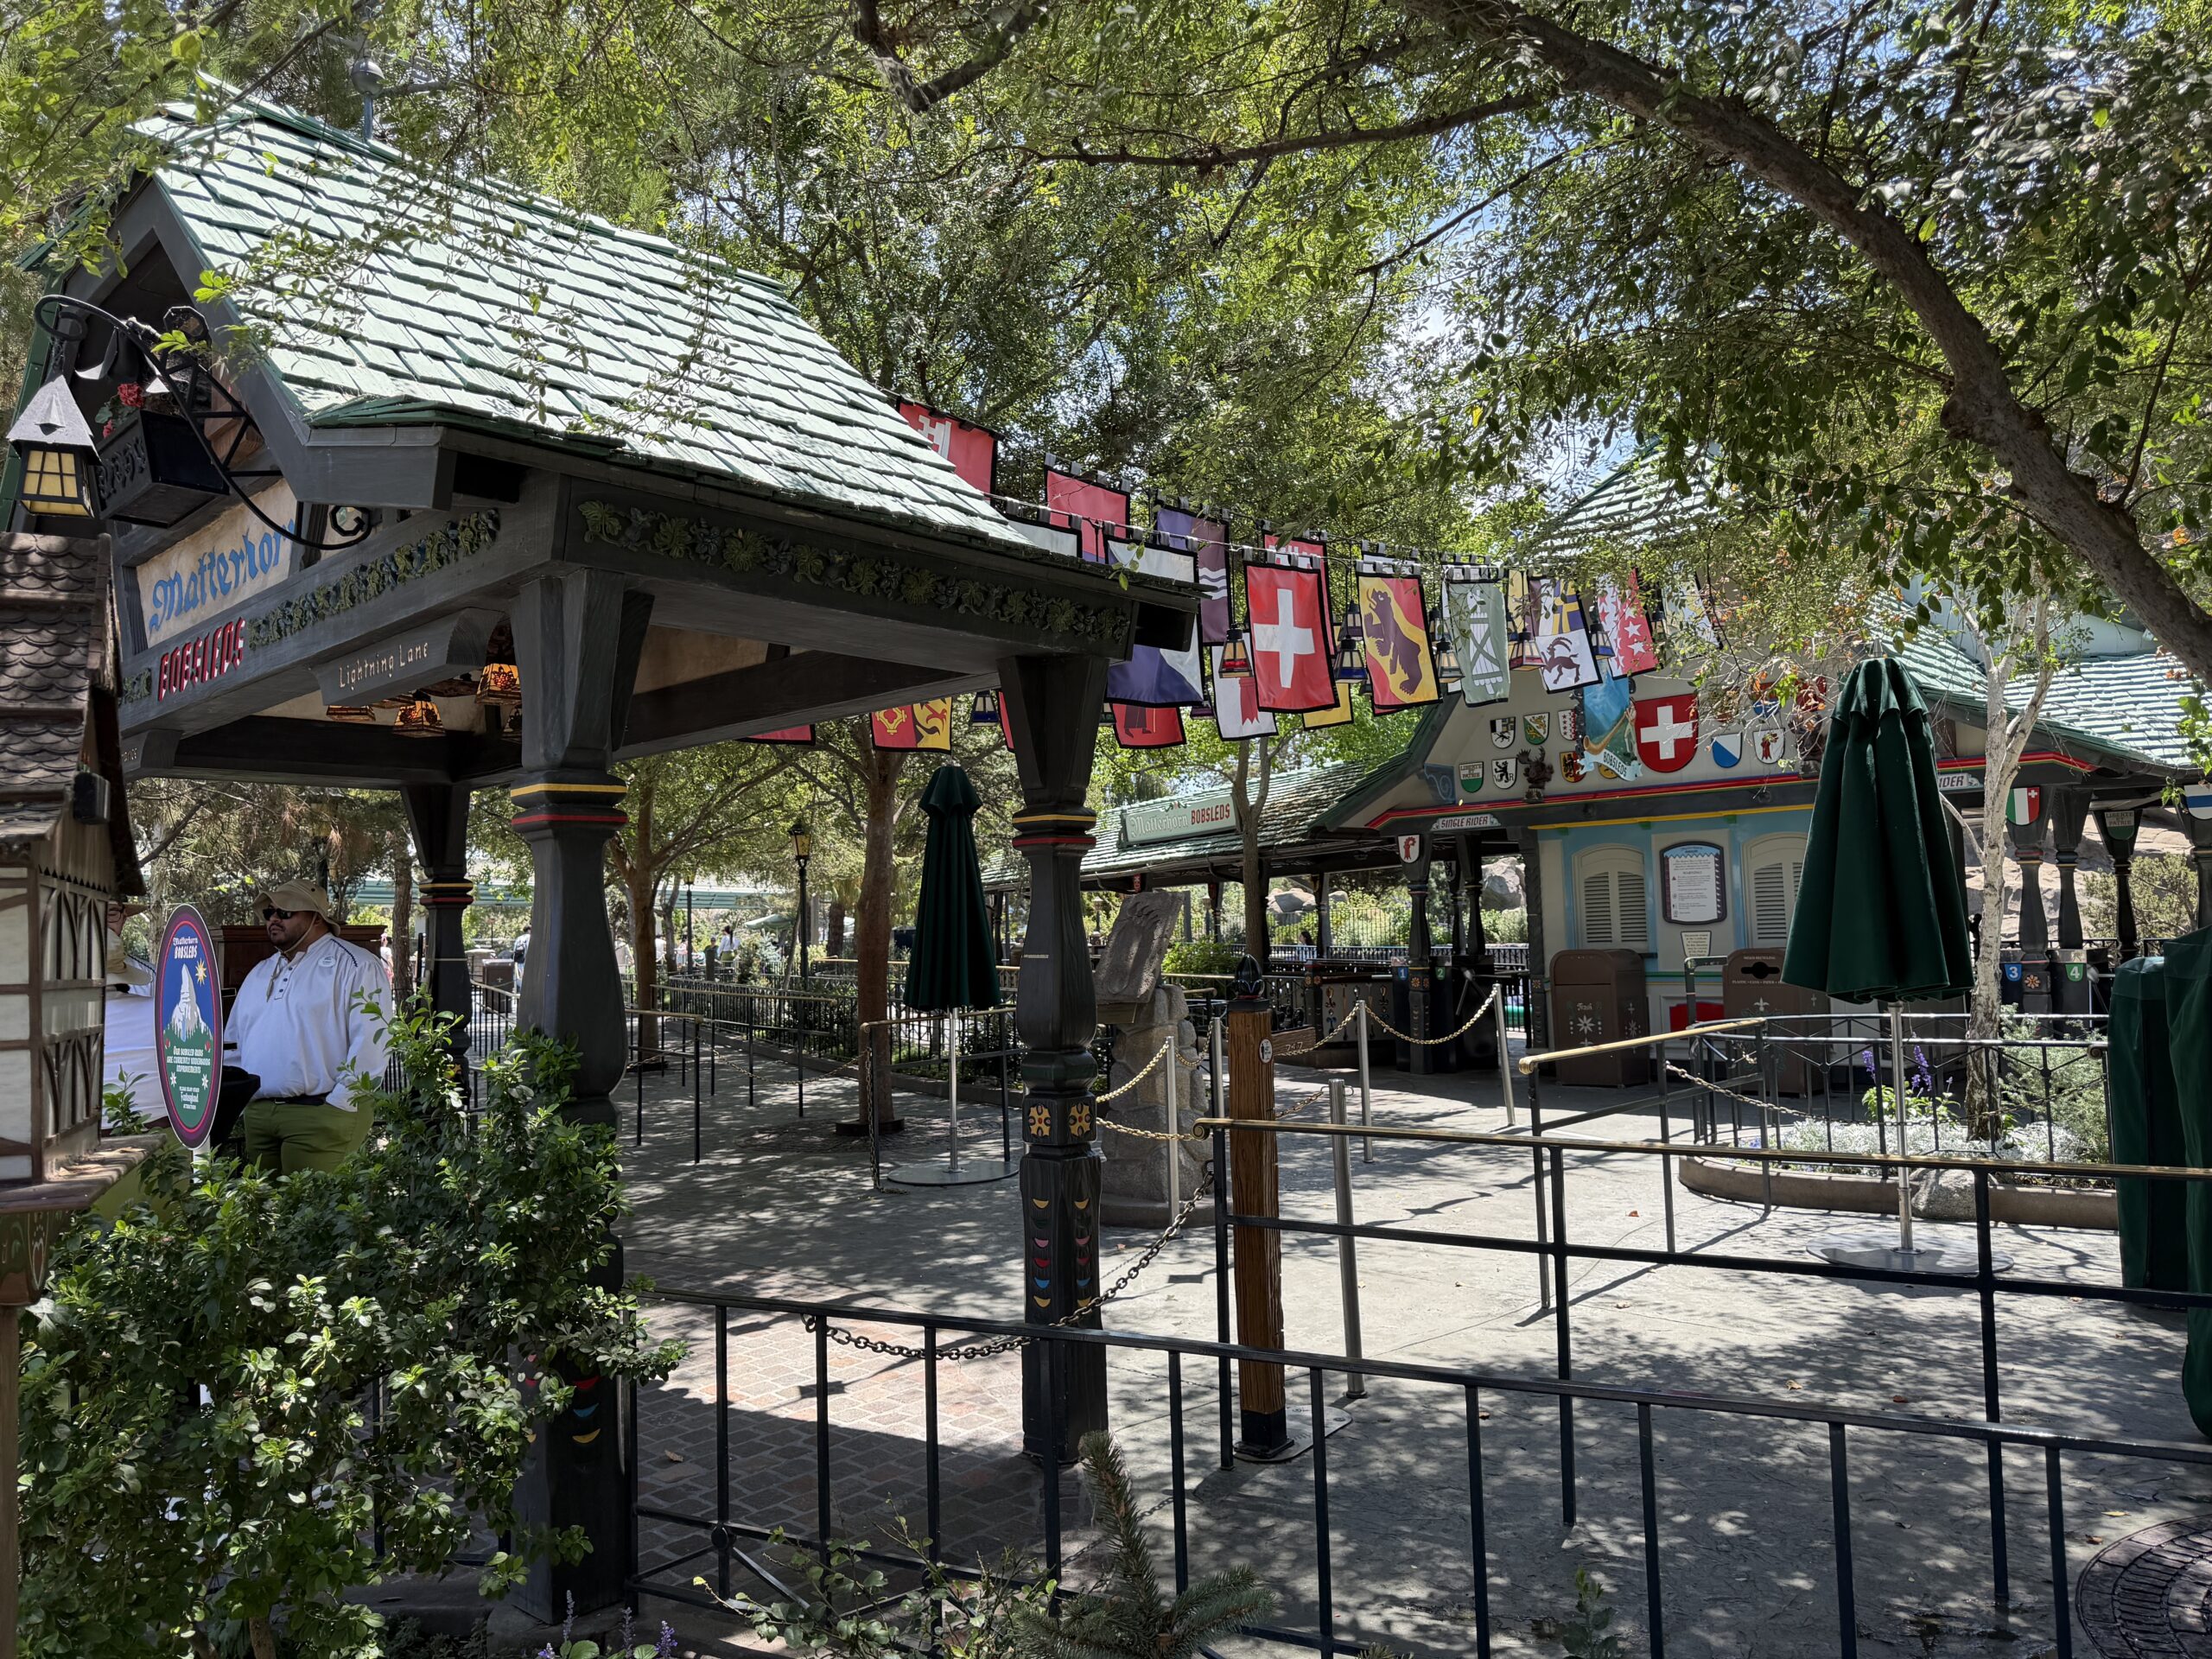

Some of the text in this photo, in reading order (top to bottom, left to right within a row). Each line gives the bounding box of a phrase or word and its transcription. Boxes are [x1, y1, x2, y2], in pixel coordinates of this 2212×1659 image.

[158, 617, 246, 702] BOBSLEDS
[340, 642, 429, 690] Lightning Lane
[1603, 751, 1627, 777] BOBSLEDS
[1939, 775, 1964, 788] IDER
[1130, 803, 1230, 838] Matterhorn BOBSLEDS
[1441, 816, 1489, 828] SINGLE RIDER
[175, 944, 197, 959] BOBSLEDS
[1400, 968, 1406, 978] 1
[1437, 968, 1444, 978] 2
[2009, 966, 2018, 978] 3
[2069, 966, 2080, 979] 4
